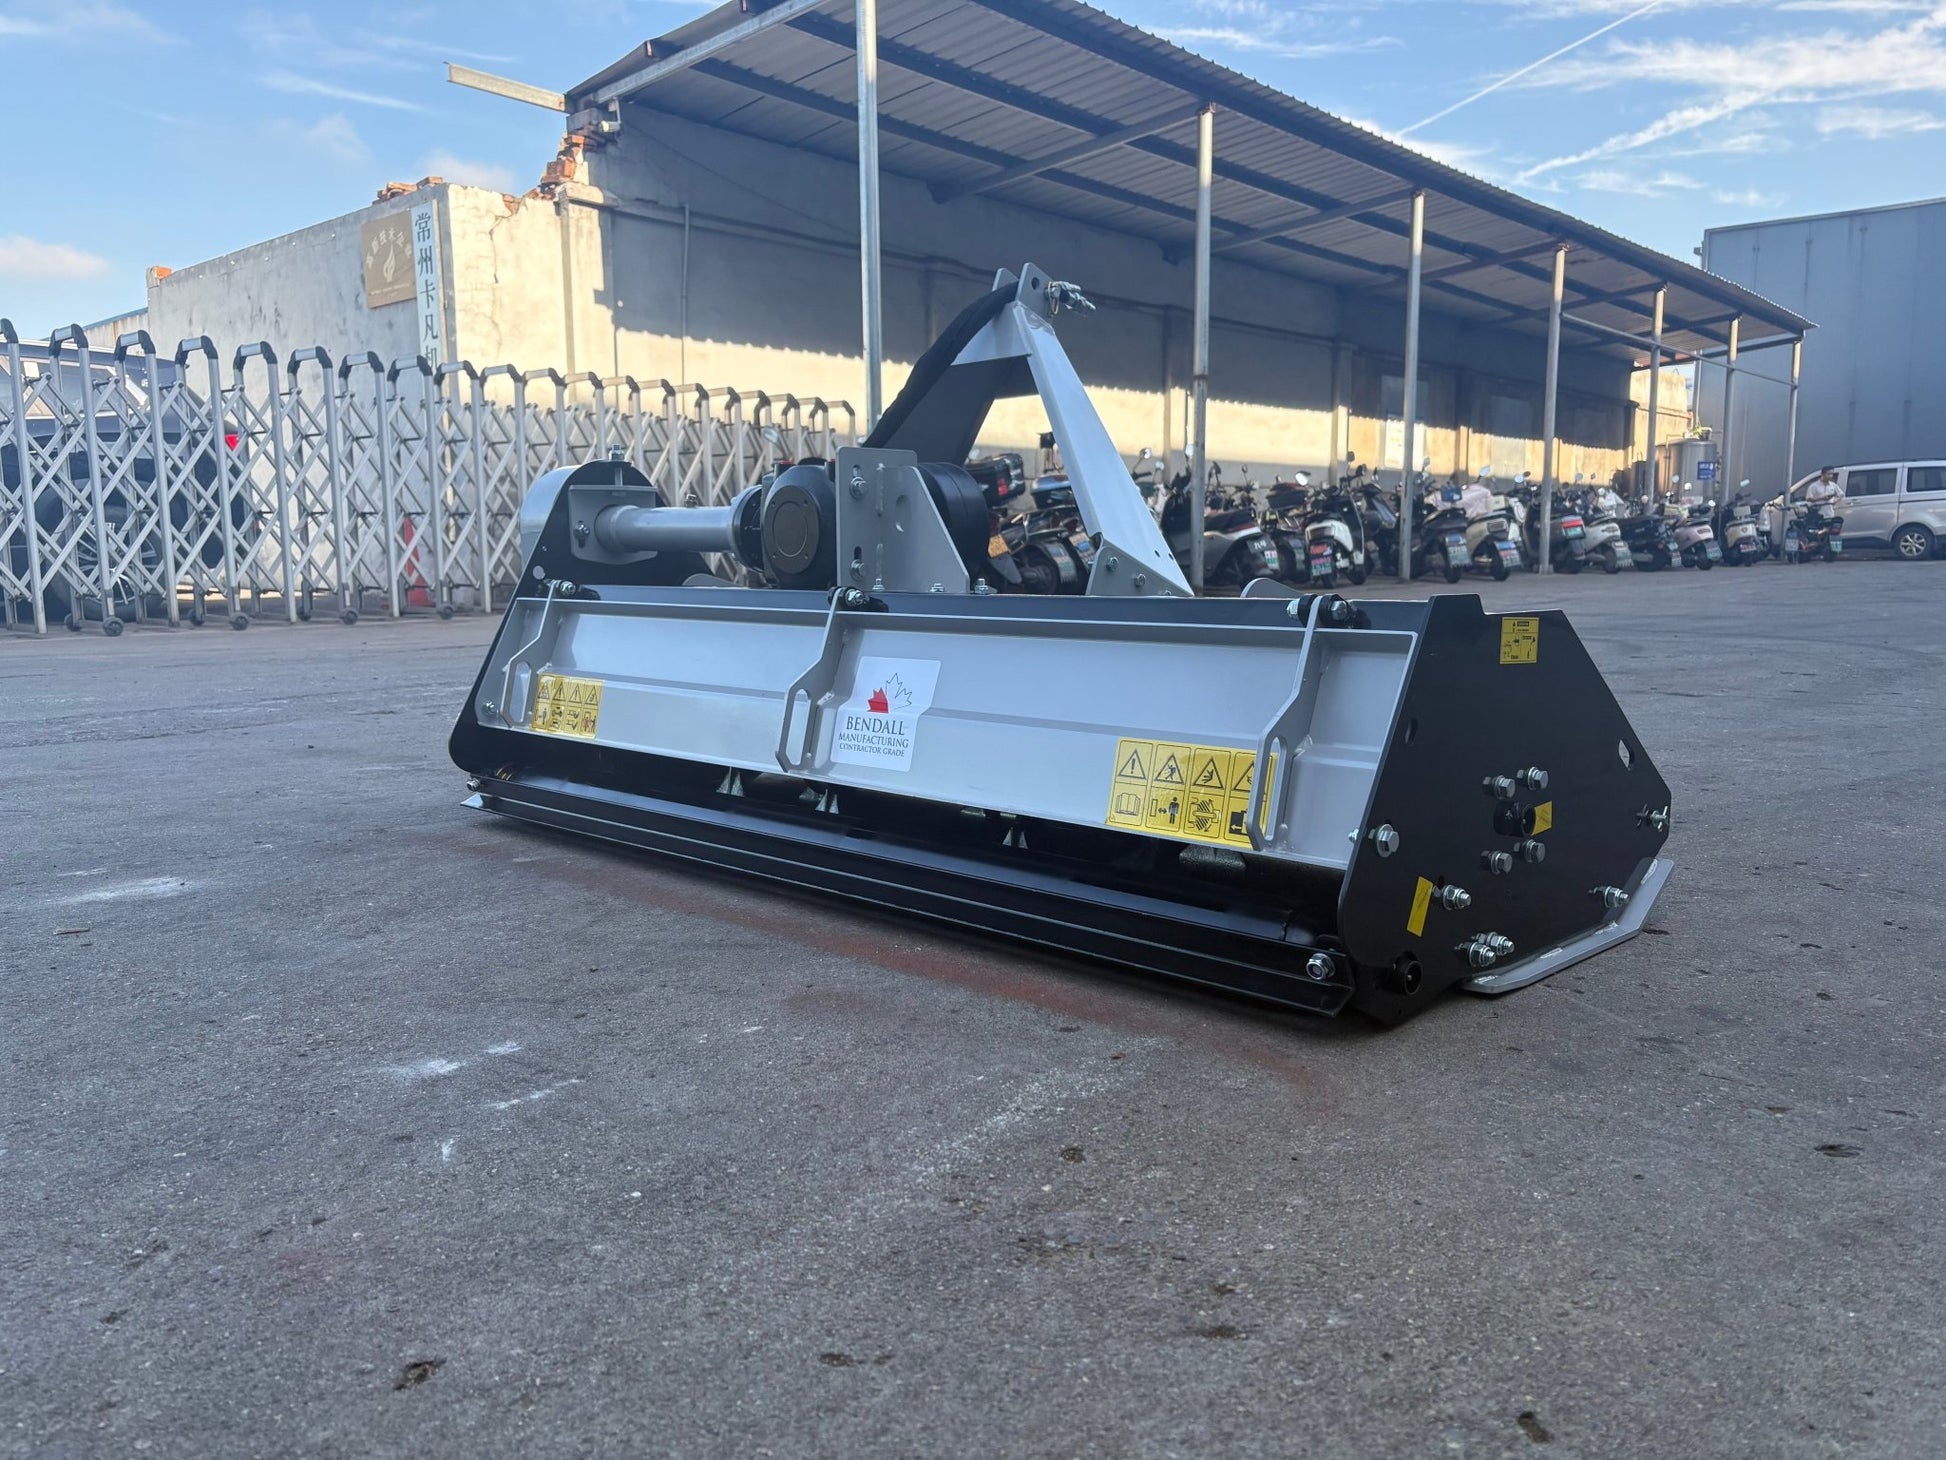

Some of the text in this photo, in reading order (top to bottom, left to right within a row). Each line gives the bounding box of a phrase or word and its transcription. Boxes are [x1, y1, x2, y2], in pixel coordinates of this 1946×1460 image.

[846, 716, 905, 735] BENDALL
[839, 732, 909, 748] MANUFACTURING
[839, 743, 905, 757] CONTRACTOR GRADE
